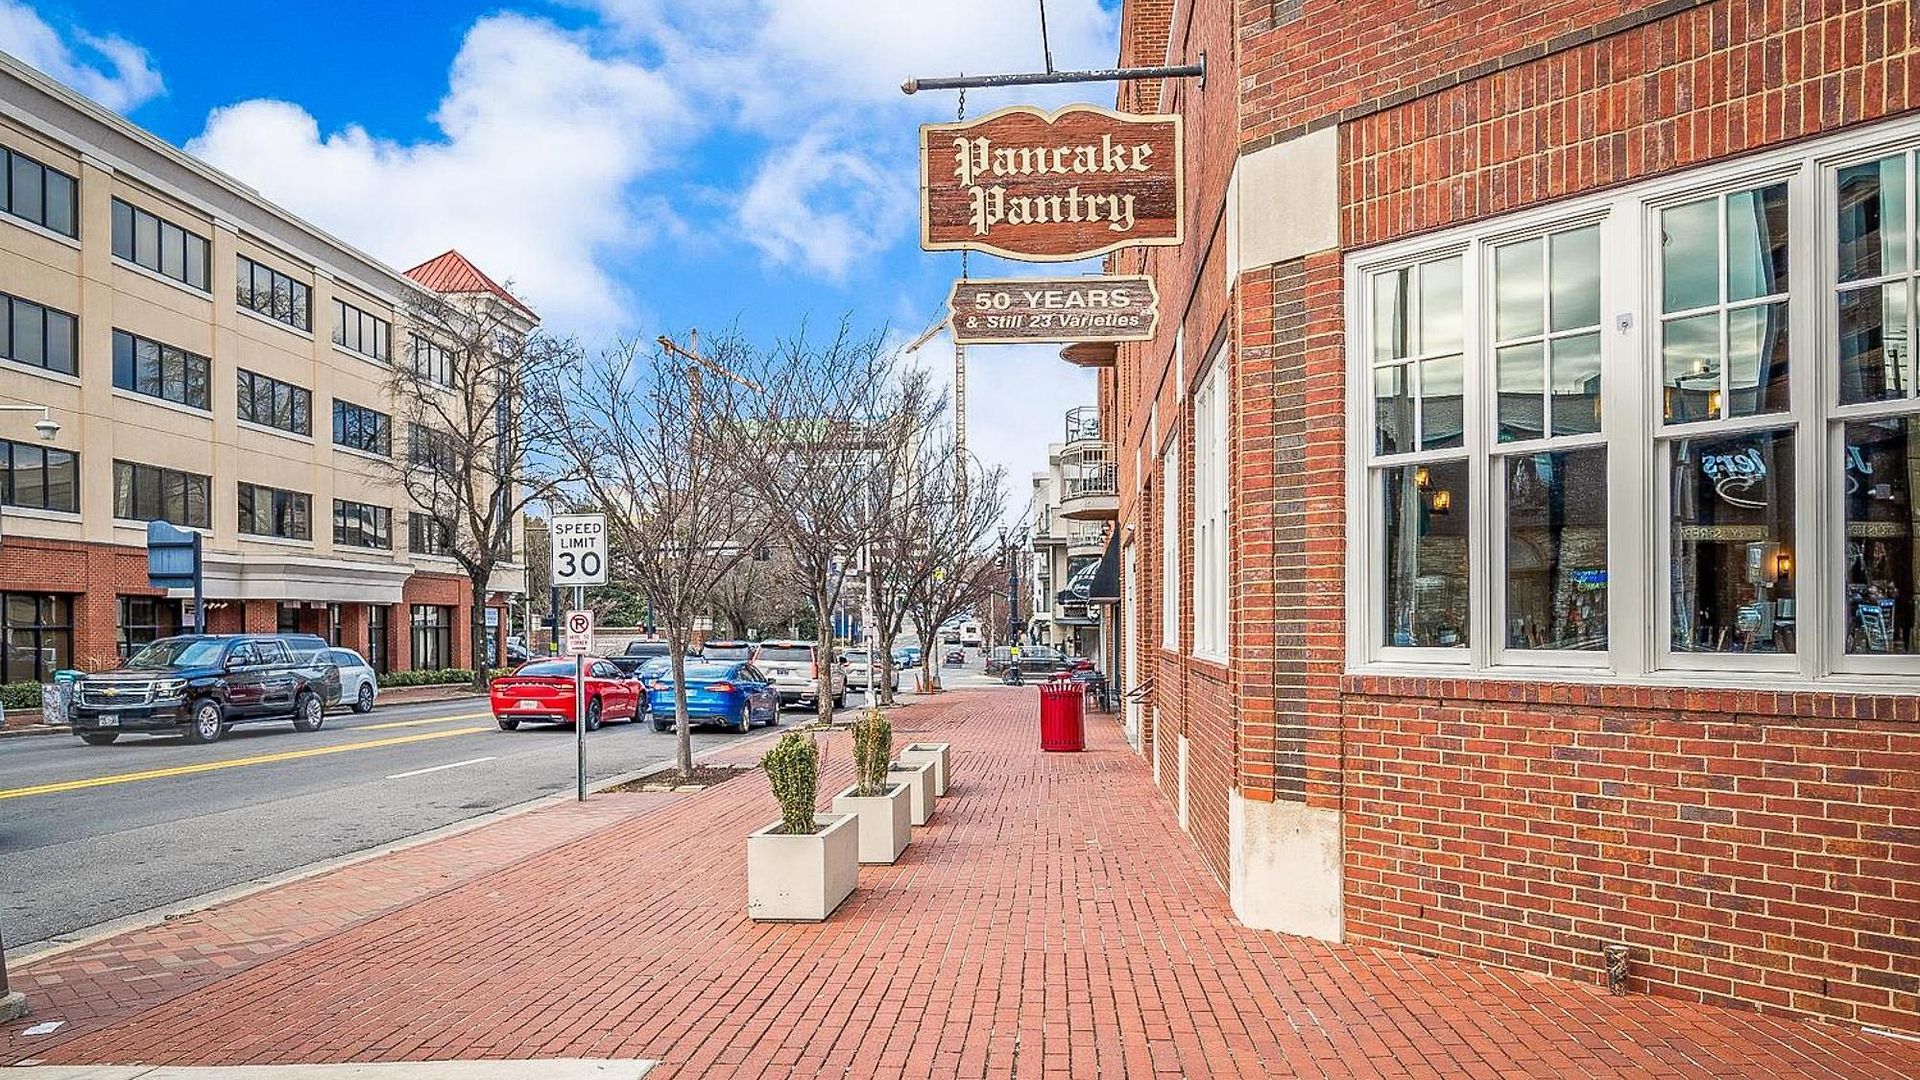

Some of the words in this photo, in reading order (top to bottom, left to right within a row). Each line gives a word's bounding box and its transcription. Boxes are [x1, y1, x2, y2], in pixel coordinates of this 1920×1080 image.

[953, 134, 1153, 187] Pancake
[968, 184, 1135, 236] Pantry
[975, 292, 1011, 311] 50
[1023, 288, 1130, 310] YEARS
[966, 315, 979, 329] &
[987, 314, 1022, 329] Still
[1029, 314, 1051, 328] 23
[1059, 313, 1139, 329] Varieties
[555, 523, 601, 535] SPEED
[560, 537, 596, 549] LIMIT
[557, 551, 601, 577] 30
